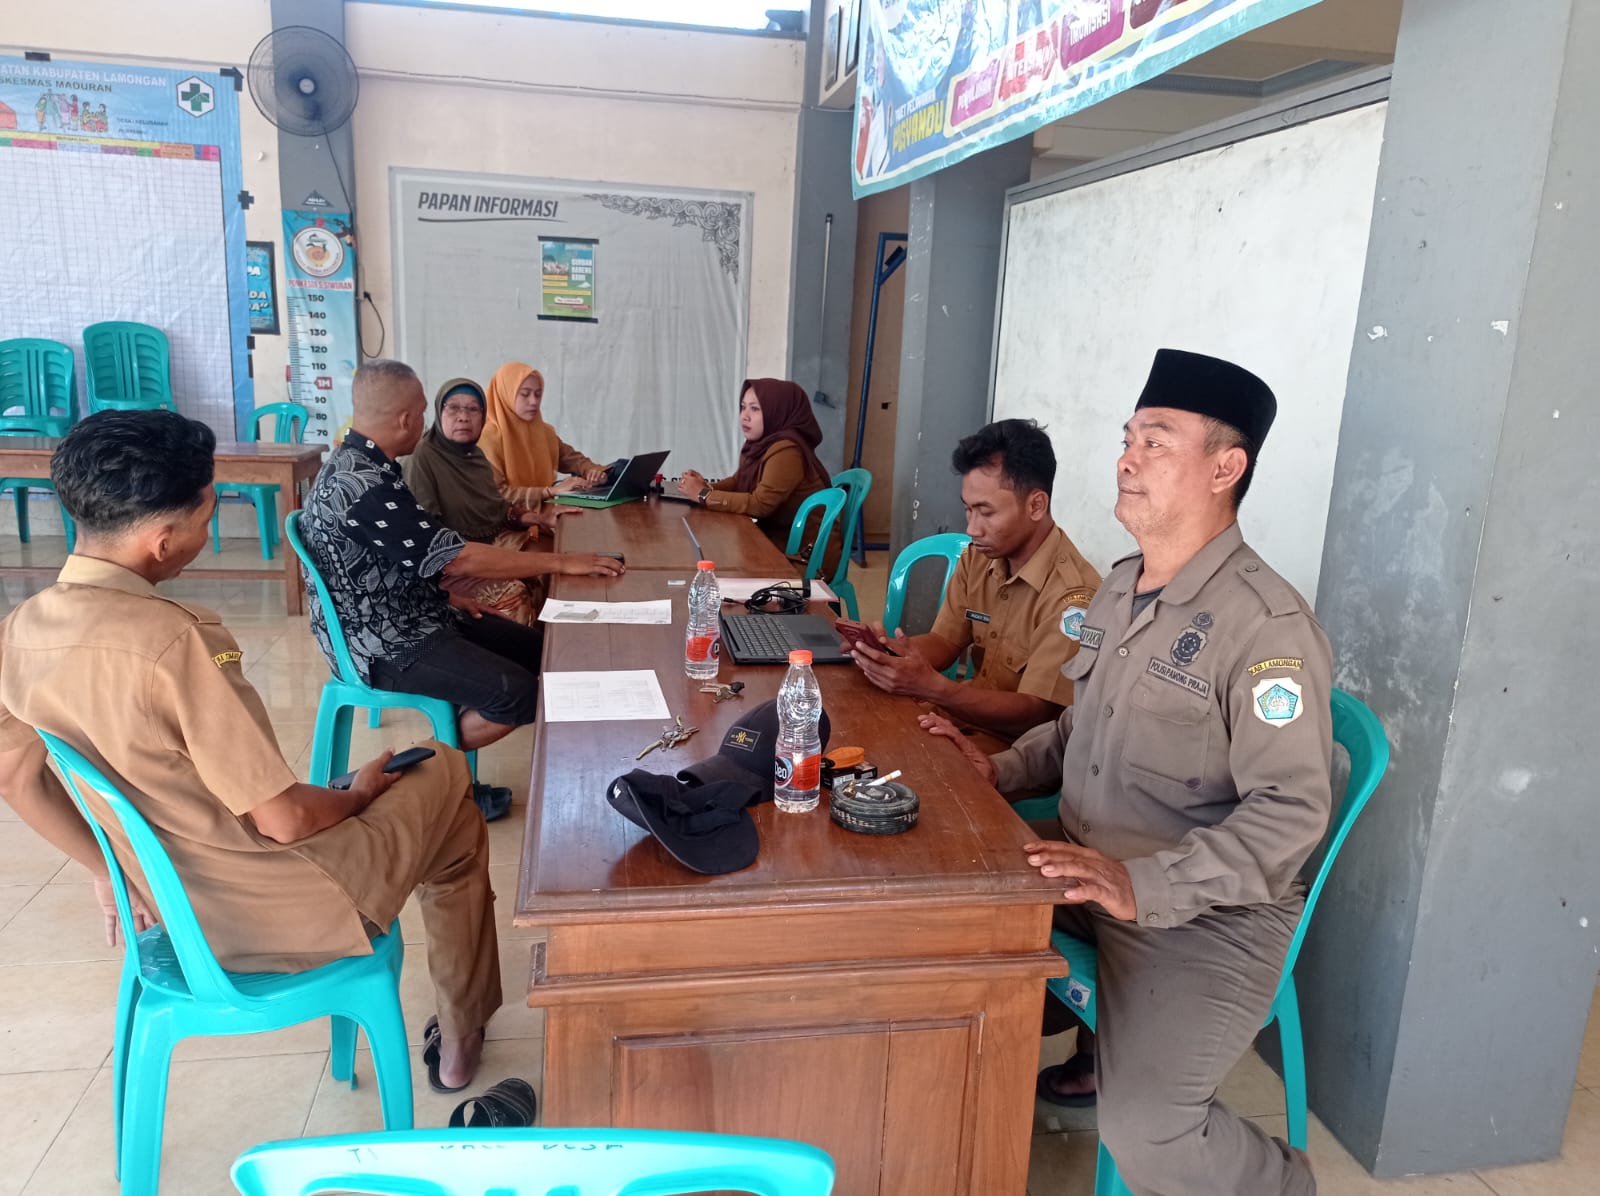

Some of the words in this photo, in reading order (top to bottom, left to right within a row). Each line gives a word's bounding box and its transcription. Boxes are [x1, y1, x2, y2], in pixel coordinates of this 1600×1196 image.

[33, 66, 99, 82] KABUPATEN
[104, 73, 167, 87] LAMONGAN
[56, 80, 112, 93] MADURAN
[418, 192, 471, 212] PAPAN
[474, 196, 559, 217] INFORMASI
[307, 294, 325, 302] 150
[308, 311, 326, 319] 140
[309, 328, 327, 336] 130
[310, 345, 327, 353] 120
[312, 362, 327, 370] 110
[316, 429, 328, 437] 70
[1150, 661, 1167, 676] POLISI
[1167, 667, 1187, 685] PAMONG
[1187, 678, 1207, 695] PRAJA
